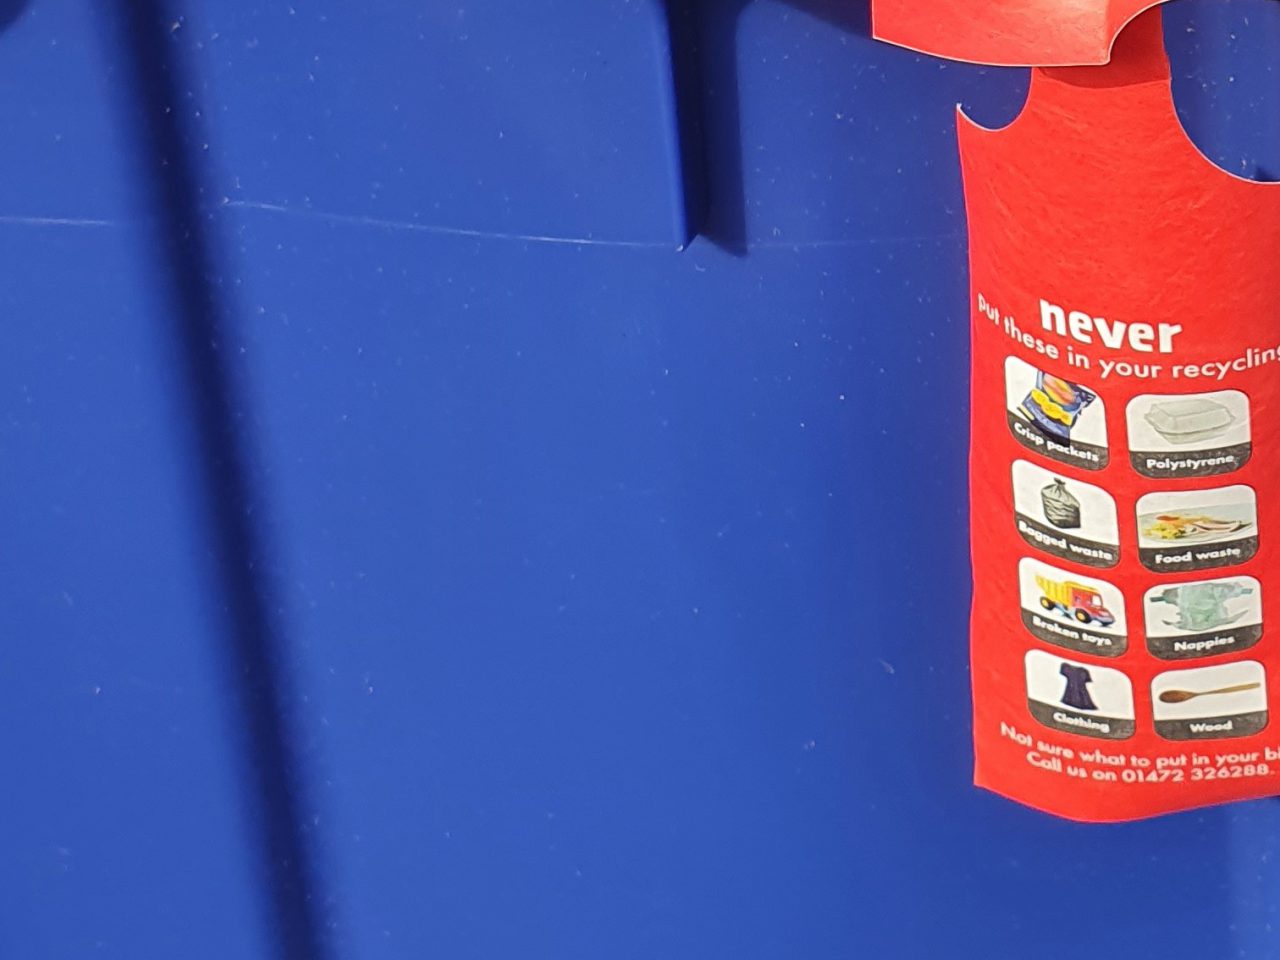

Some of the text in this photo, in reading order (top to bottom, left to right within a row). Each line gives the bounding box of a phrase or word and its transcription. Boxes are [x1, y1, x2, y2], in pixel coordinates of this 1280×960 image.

[977, 292, 1000, 326] put
[1003, 315, 1059, 360] these
[1066, 344, 1090, 369] in
[1099, 359, 1162, 379] your
[1040, 299, 1183, 353] never
[1014, 421, 1099, 463] Crisp packets
[1146, 454, 1235, 471] Polystyrene
[1018, 519, 1114, 561] Bagged waste
[1154, 547, 1241, 565] Food waste
[1173, 636, 1236, 652] Nappies
[1053, 711, 1111, 734] Clothing
[1188, 720, 1234, 733] Wood
[1000, 720, 1033, 747] Not
[1036, 740, 1075, 760] sure
[1078, 749, 1126, 766] what
[1129, 754, 1151, 767] to
[1155, 753, 1188, 770] put
[1192, 752, 1211, 766] in
[1215, 750, 1261, 767] your
[1026, 751, 1063, 773] Call
[1066, 765, 1088, 778] us
[1091, 770, 1118, 782] on
[1121, 768, 1185, 783] 01472
